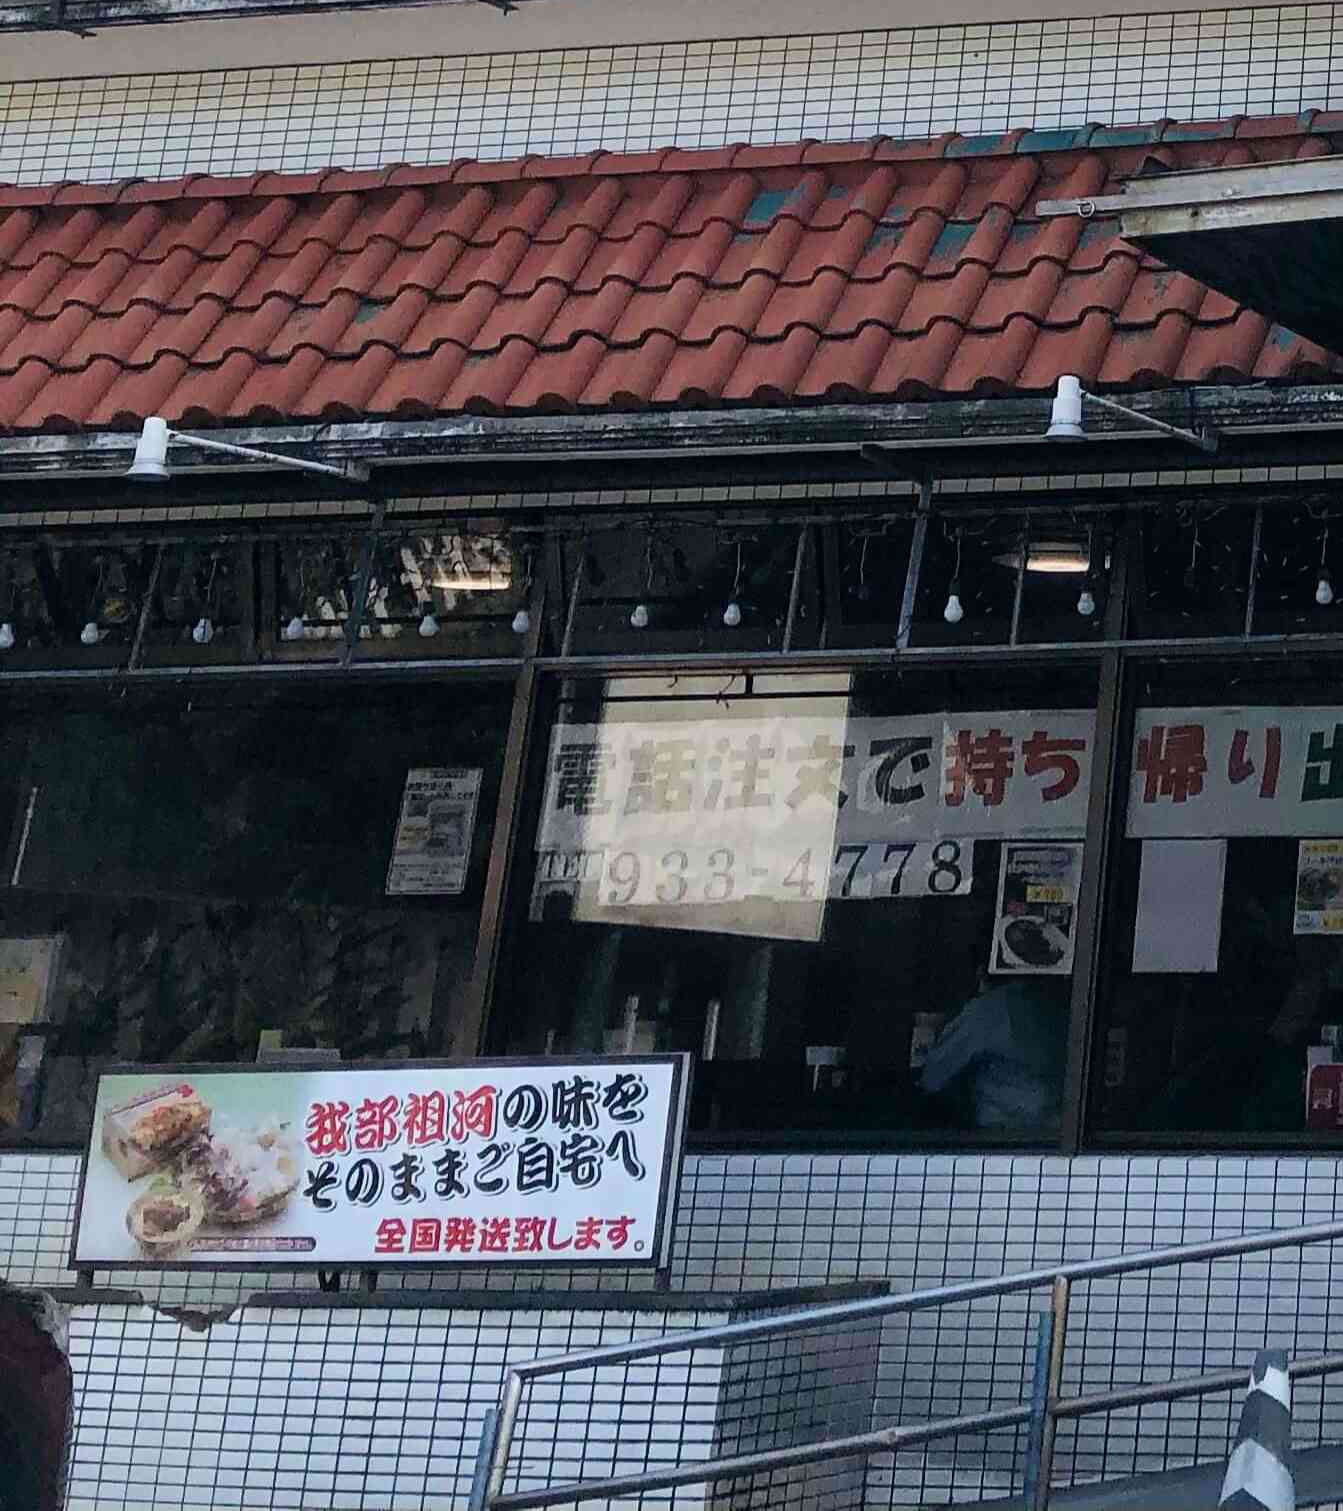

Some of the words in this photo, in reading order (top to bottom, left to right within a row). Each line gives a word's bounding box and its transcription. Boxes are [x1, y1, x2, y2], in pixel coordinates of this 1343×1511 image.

[607, 839, 963, 905] 933-4778
[304, 1072, 650, 1158] 我部祖河の味を
[301, 1129, 647, 1211] そのままご自宅へ
[374, 1215, 646, 1255] 全国発送致します。
